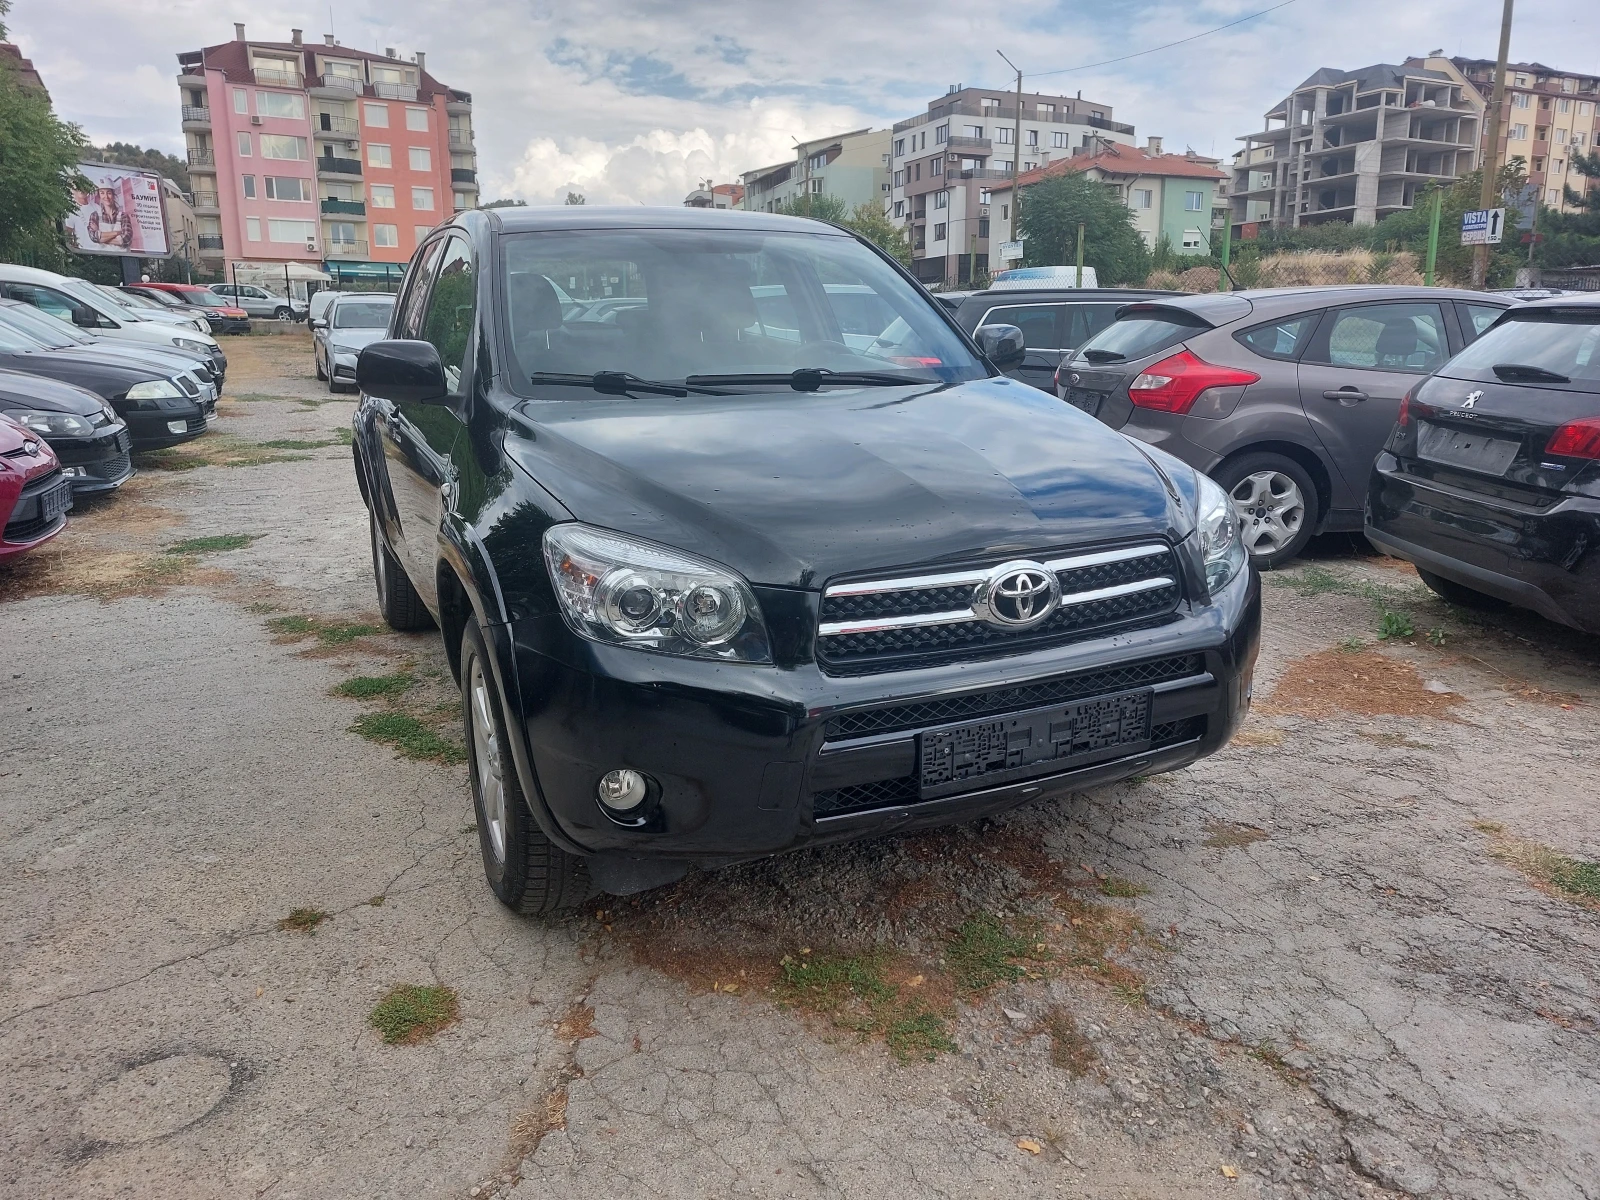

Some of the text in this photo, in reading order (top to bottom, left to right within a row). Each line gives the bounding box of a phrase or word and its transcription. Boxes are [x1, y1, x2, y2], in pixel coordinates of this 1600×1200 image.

[131, 194, 157, 202] БАУМИТ
[1464, 211, 1486, 224] VISTA
[1462, 231, 1485, 241] СЕРВИЗ
[1450, 410, 1478, 419] PEUGEOT
